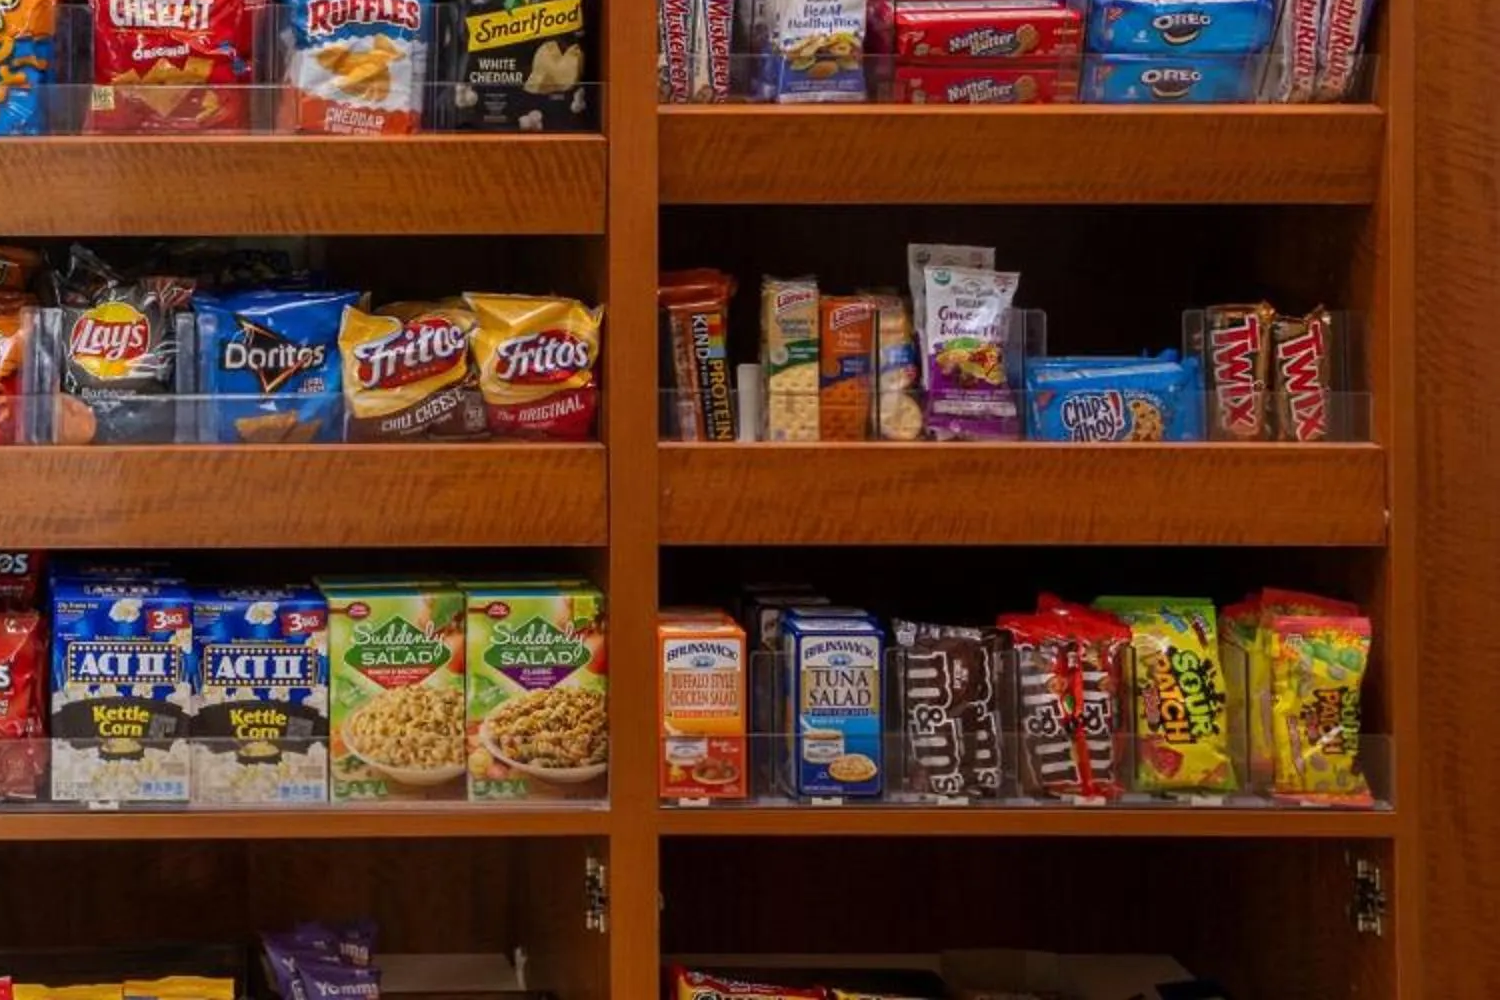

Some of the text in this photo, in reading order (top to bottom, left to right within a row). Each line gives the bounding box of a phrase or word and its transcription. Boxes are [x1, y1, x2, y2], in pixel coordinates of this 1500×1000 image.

[475, 3, 580, 44] Smartfood
[1153, 12, 1211, 29] OREO
[478, 57, 517, 70] WHITE
[469, 71, 524, 84] CHEDDAR
[1141, 67, 1201, 83] OREO
[691, 313, 711, 360] KIND
[224, 343, 326, 369] Doritos
[497, 332, 589, 381] Fritos
[1211, 314, 1260, 431] TWIX
[1278, 320, 1327, 441] TWIX
[415, 387, 466, 424] CHEESE
[518, 394, 585, 422] ORIGINAL
[708, 359, 732, 440] PROTEIN
[1063, 395, 1111, 429] Chips
[153, 610, 166, 629] 3
[288, 613, 302, 632] 3
[352, 620, 445, 657] Suddenly
[489, 621, 584, 657] Suddenly
[361, 651, 433, 665] SALAD
[501, 651, 573, 665] SALAD
[667, 642, 738, 662] BRUNSWICK
[804, 640, 877, 661] BRUNSWICK
[79, 652, 167, 676] ACT II
[215, 655, 303, 679] ACT II
[812, 669, 869, 687] TUNA
[808, 689, 872, 707] SALAD
[1152, 653, 1198, 745] PATCH
[1171, 650, 1214, 737] SOUR
[93, 705, 150, 723] Kettle
[230, 709, 288, 726] Kettle
[99, 722, 143, 738] Corn
[236, 725, 280, 740] Corn
